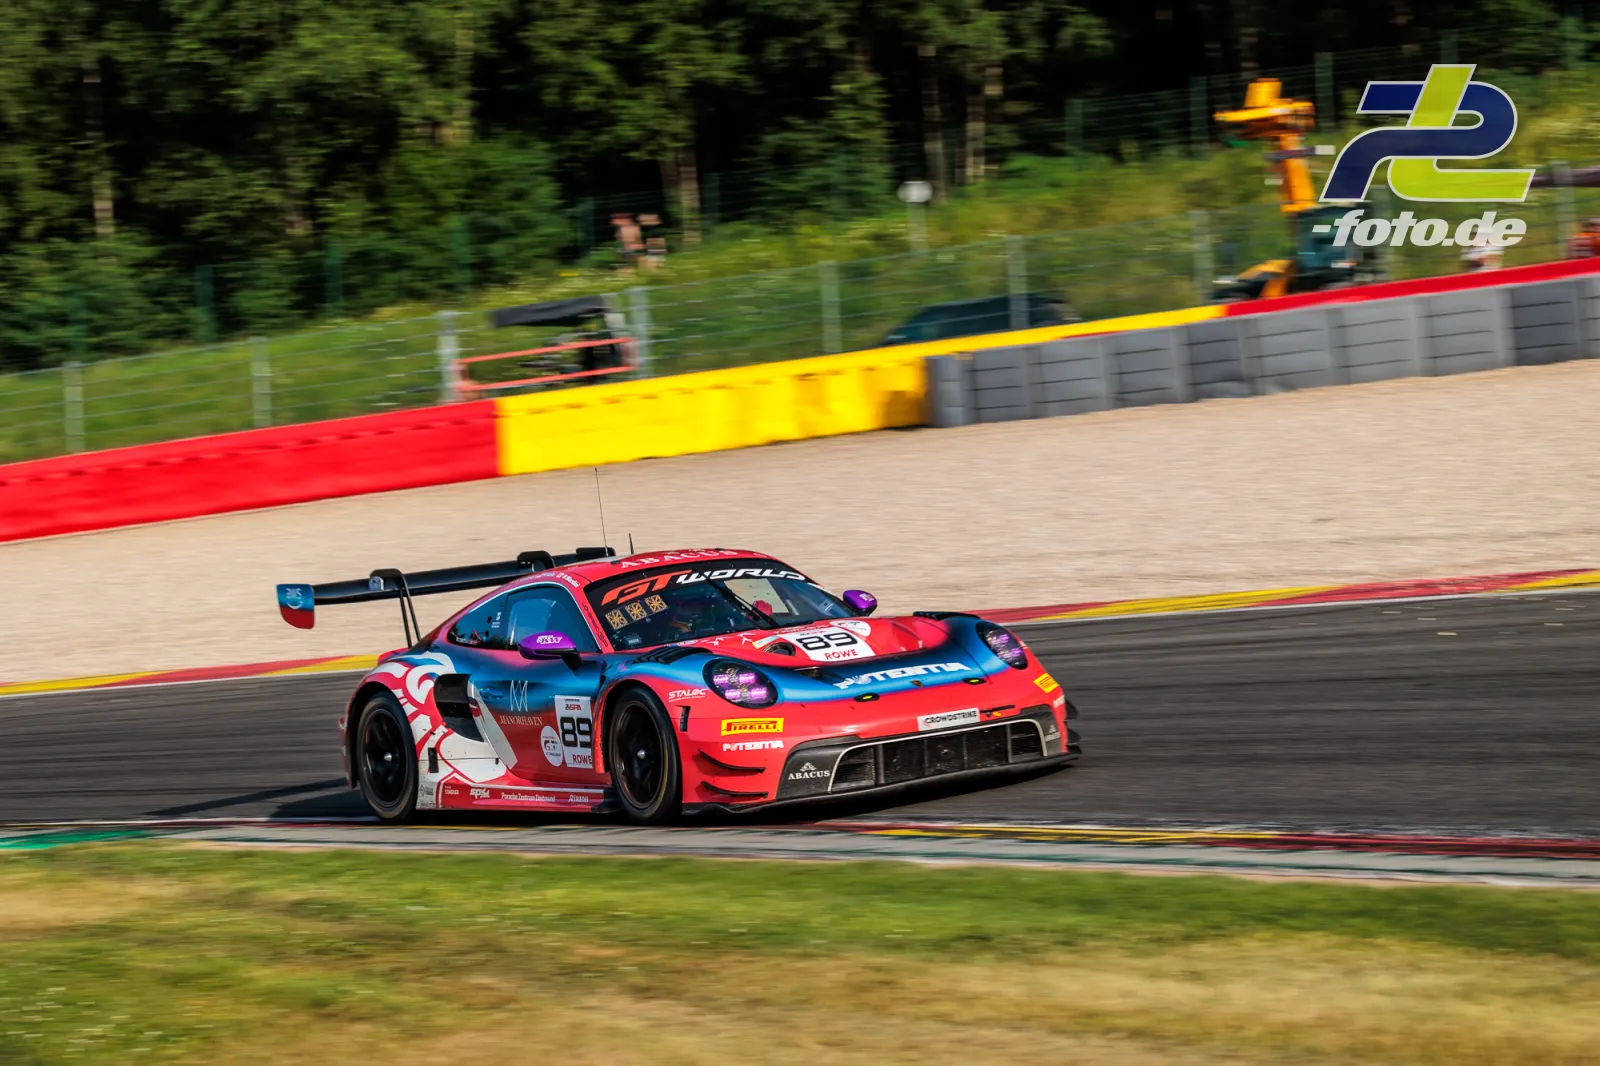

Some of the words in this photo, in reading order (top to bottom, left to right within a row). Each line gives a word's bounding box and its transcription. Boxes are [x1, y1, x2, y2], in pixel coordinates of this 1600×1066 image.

[621, 549, 738, 568] ABACUS
[676, 568, 806, 585] WORLD
[796, 632, 858, 650] 89
[824, 649, 858, 660] ROWE
[925, 710, 978, 724] CROWDSTRIKE
[560, 716, 592, 748] 89
[726, 721, 778, 731] PIRELLI
[572, 754, 593, 764] ROWE
[788, 771, 830, 780] ABACUS
